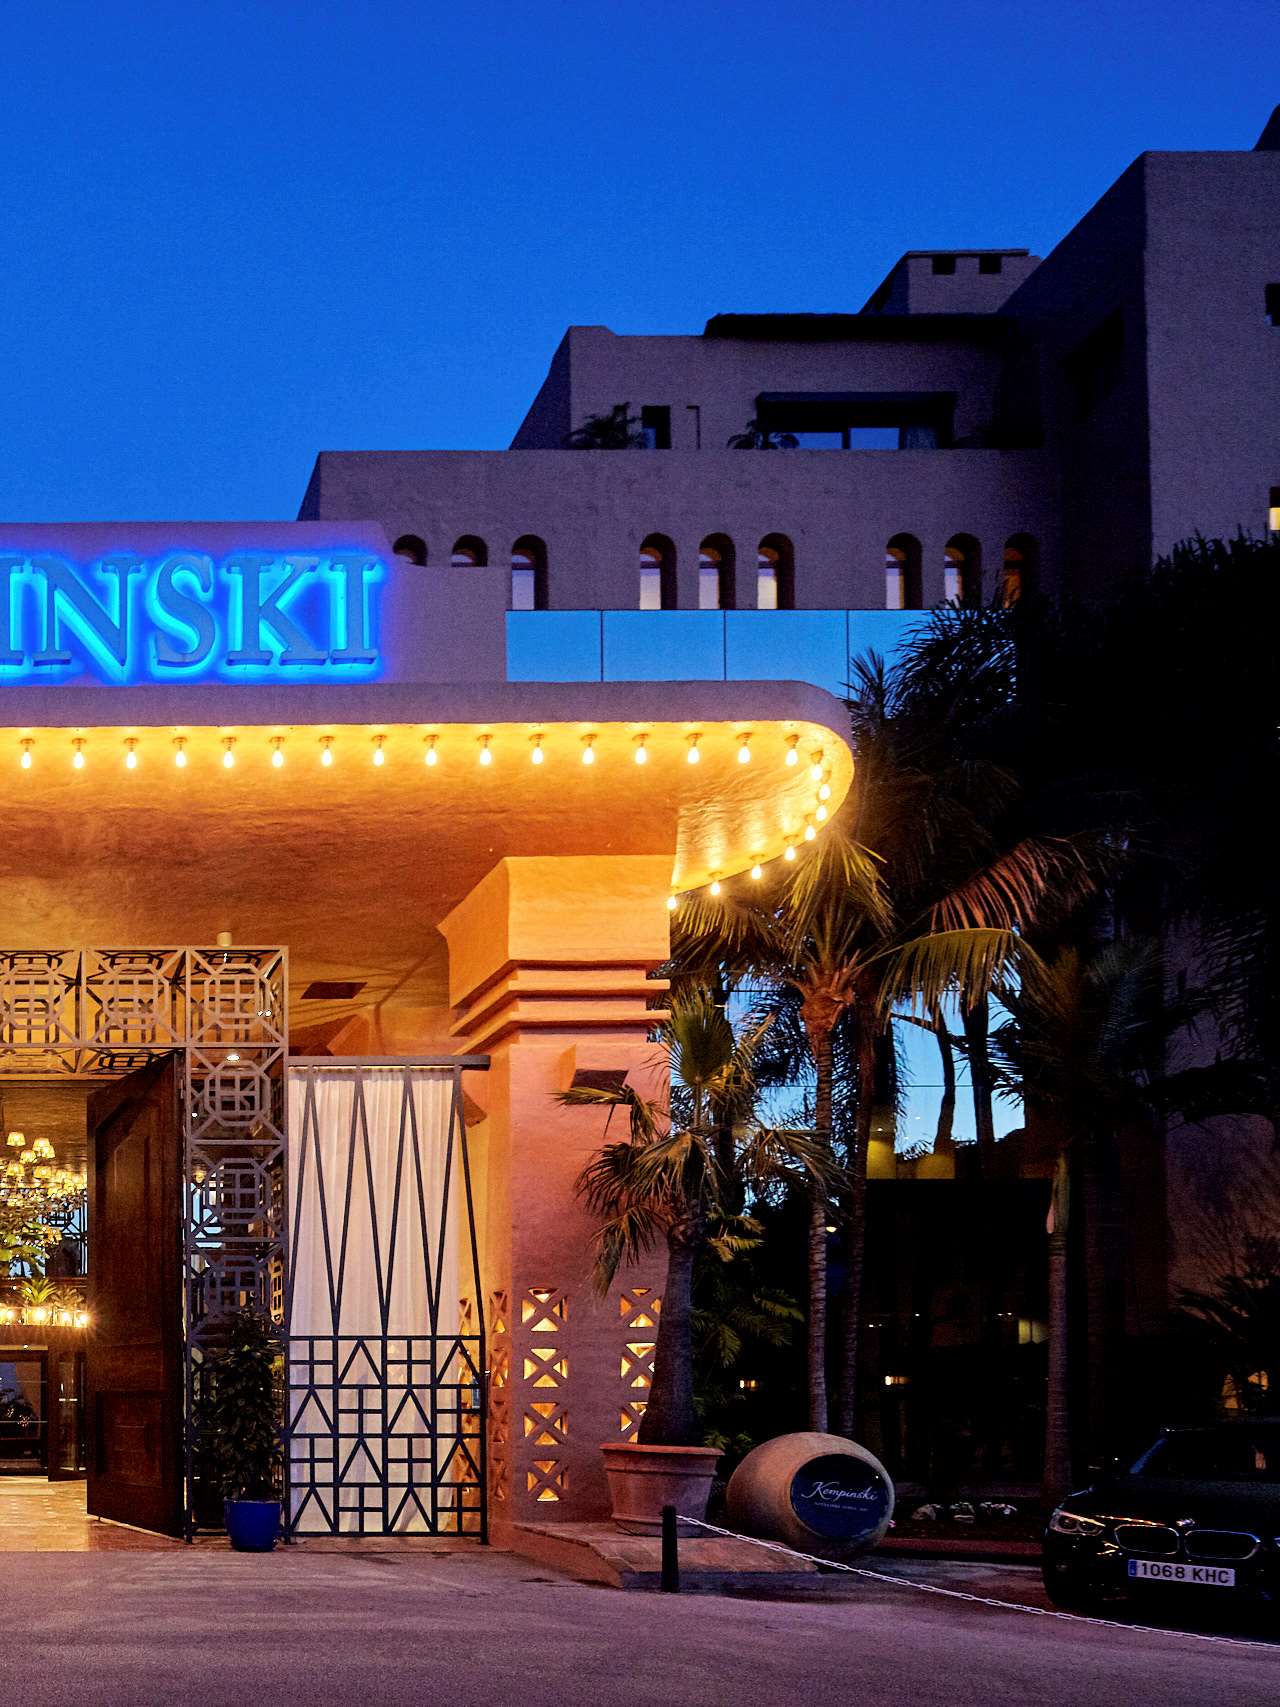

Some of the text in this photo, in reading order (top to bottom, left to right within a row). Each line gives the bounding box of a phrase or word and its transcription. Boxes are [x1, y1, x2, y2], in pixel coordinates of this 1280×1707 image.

[801, 1481, 878, 1501] Kempinski
[1141, 1562, 1229, 1584] 1068 KHC
